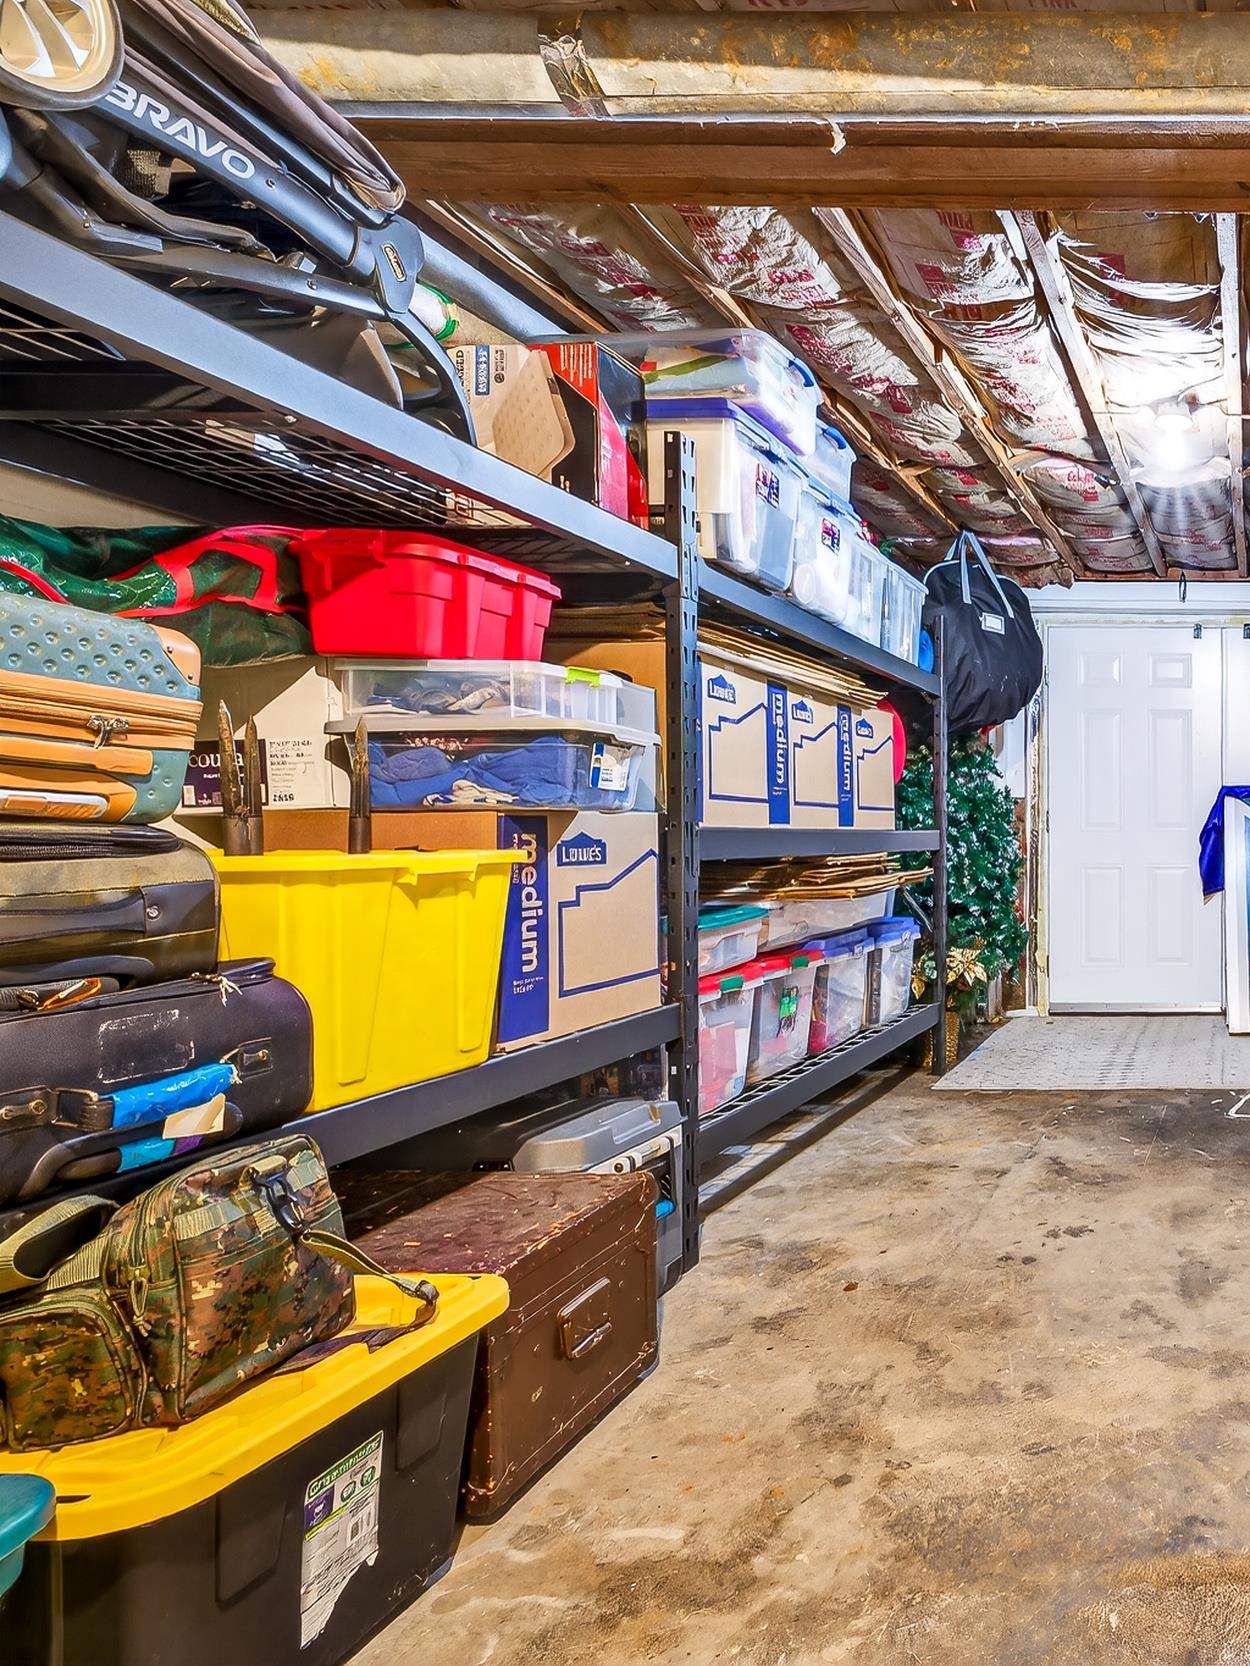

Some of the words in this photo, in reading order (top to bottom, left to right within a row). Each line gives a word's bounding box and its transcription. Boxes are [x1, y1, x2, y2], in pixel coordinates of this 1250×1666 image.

[105, 81, 256, 179] BRAVO
[521, 833, 544, 973] medium
[562, 845, 602, 863] LOWE'S
